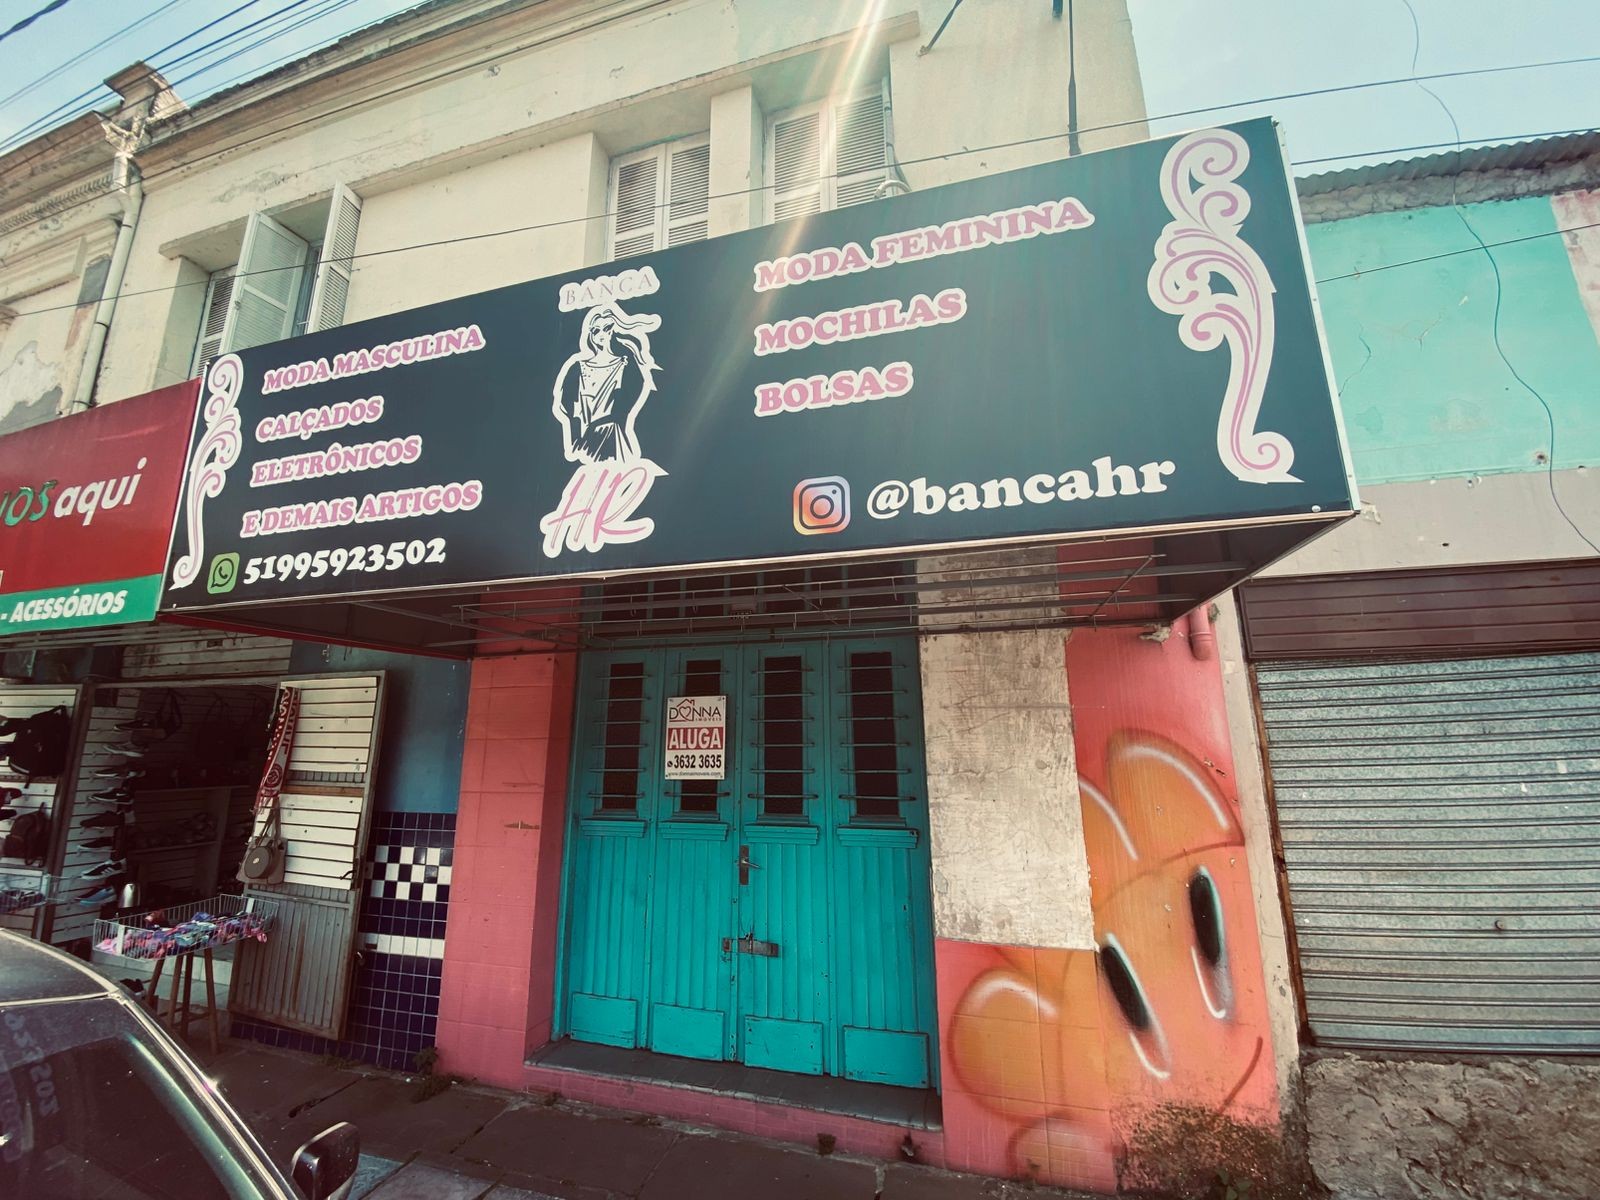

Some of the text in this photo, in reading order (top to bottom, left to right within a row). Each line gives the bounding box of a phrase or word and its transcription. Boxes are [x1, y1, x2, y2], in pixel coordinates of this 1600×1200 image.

[756, 200, 1091, 289] MODA FEMININA
[564, 272, 654, 306] BANCA
[757, 291, 964, 353] MOCHILAS
[262, 327, 483, 393] MODA MASCULINA
[757, 365, 911, 414] BOLSAS
[257, 397, 383, 437] CALÇADOS
[251, 437, 420, 484] ELETRÔNICOS
[54, 457, 148, 526] aqui
[242, 483, 481, 535] E DEMAIS ARTIGOS
[546, 466, 649, 550] HR
[866, 456, 1176, 520] @bancahr
[243, 537, 446, 584] 51995923502
[9, 588, 128, 623] ACESSÓRIOS
[668, 727, 722, 749] ALUGA
[674, 755, 722, 768] 3632 3635
